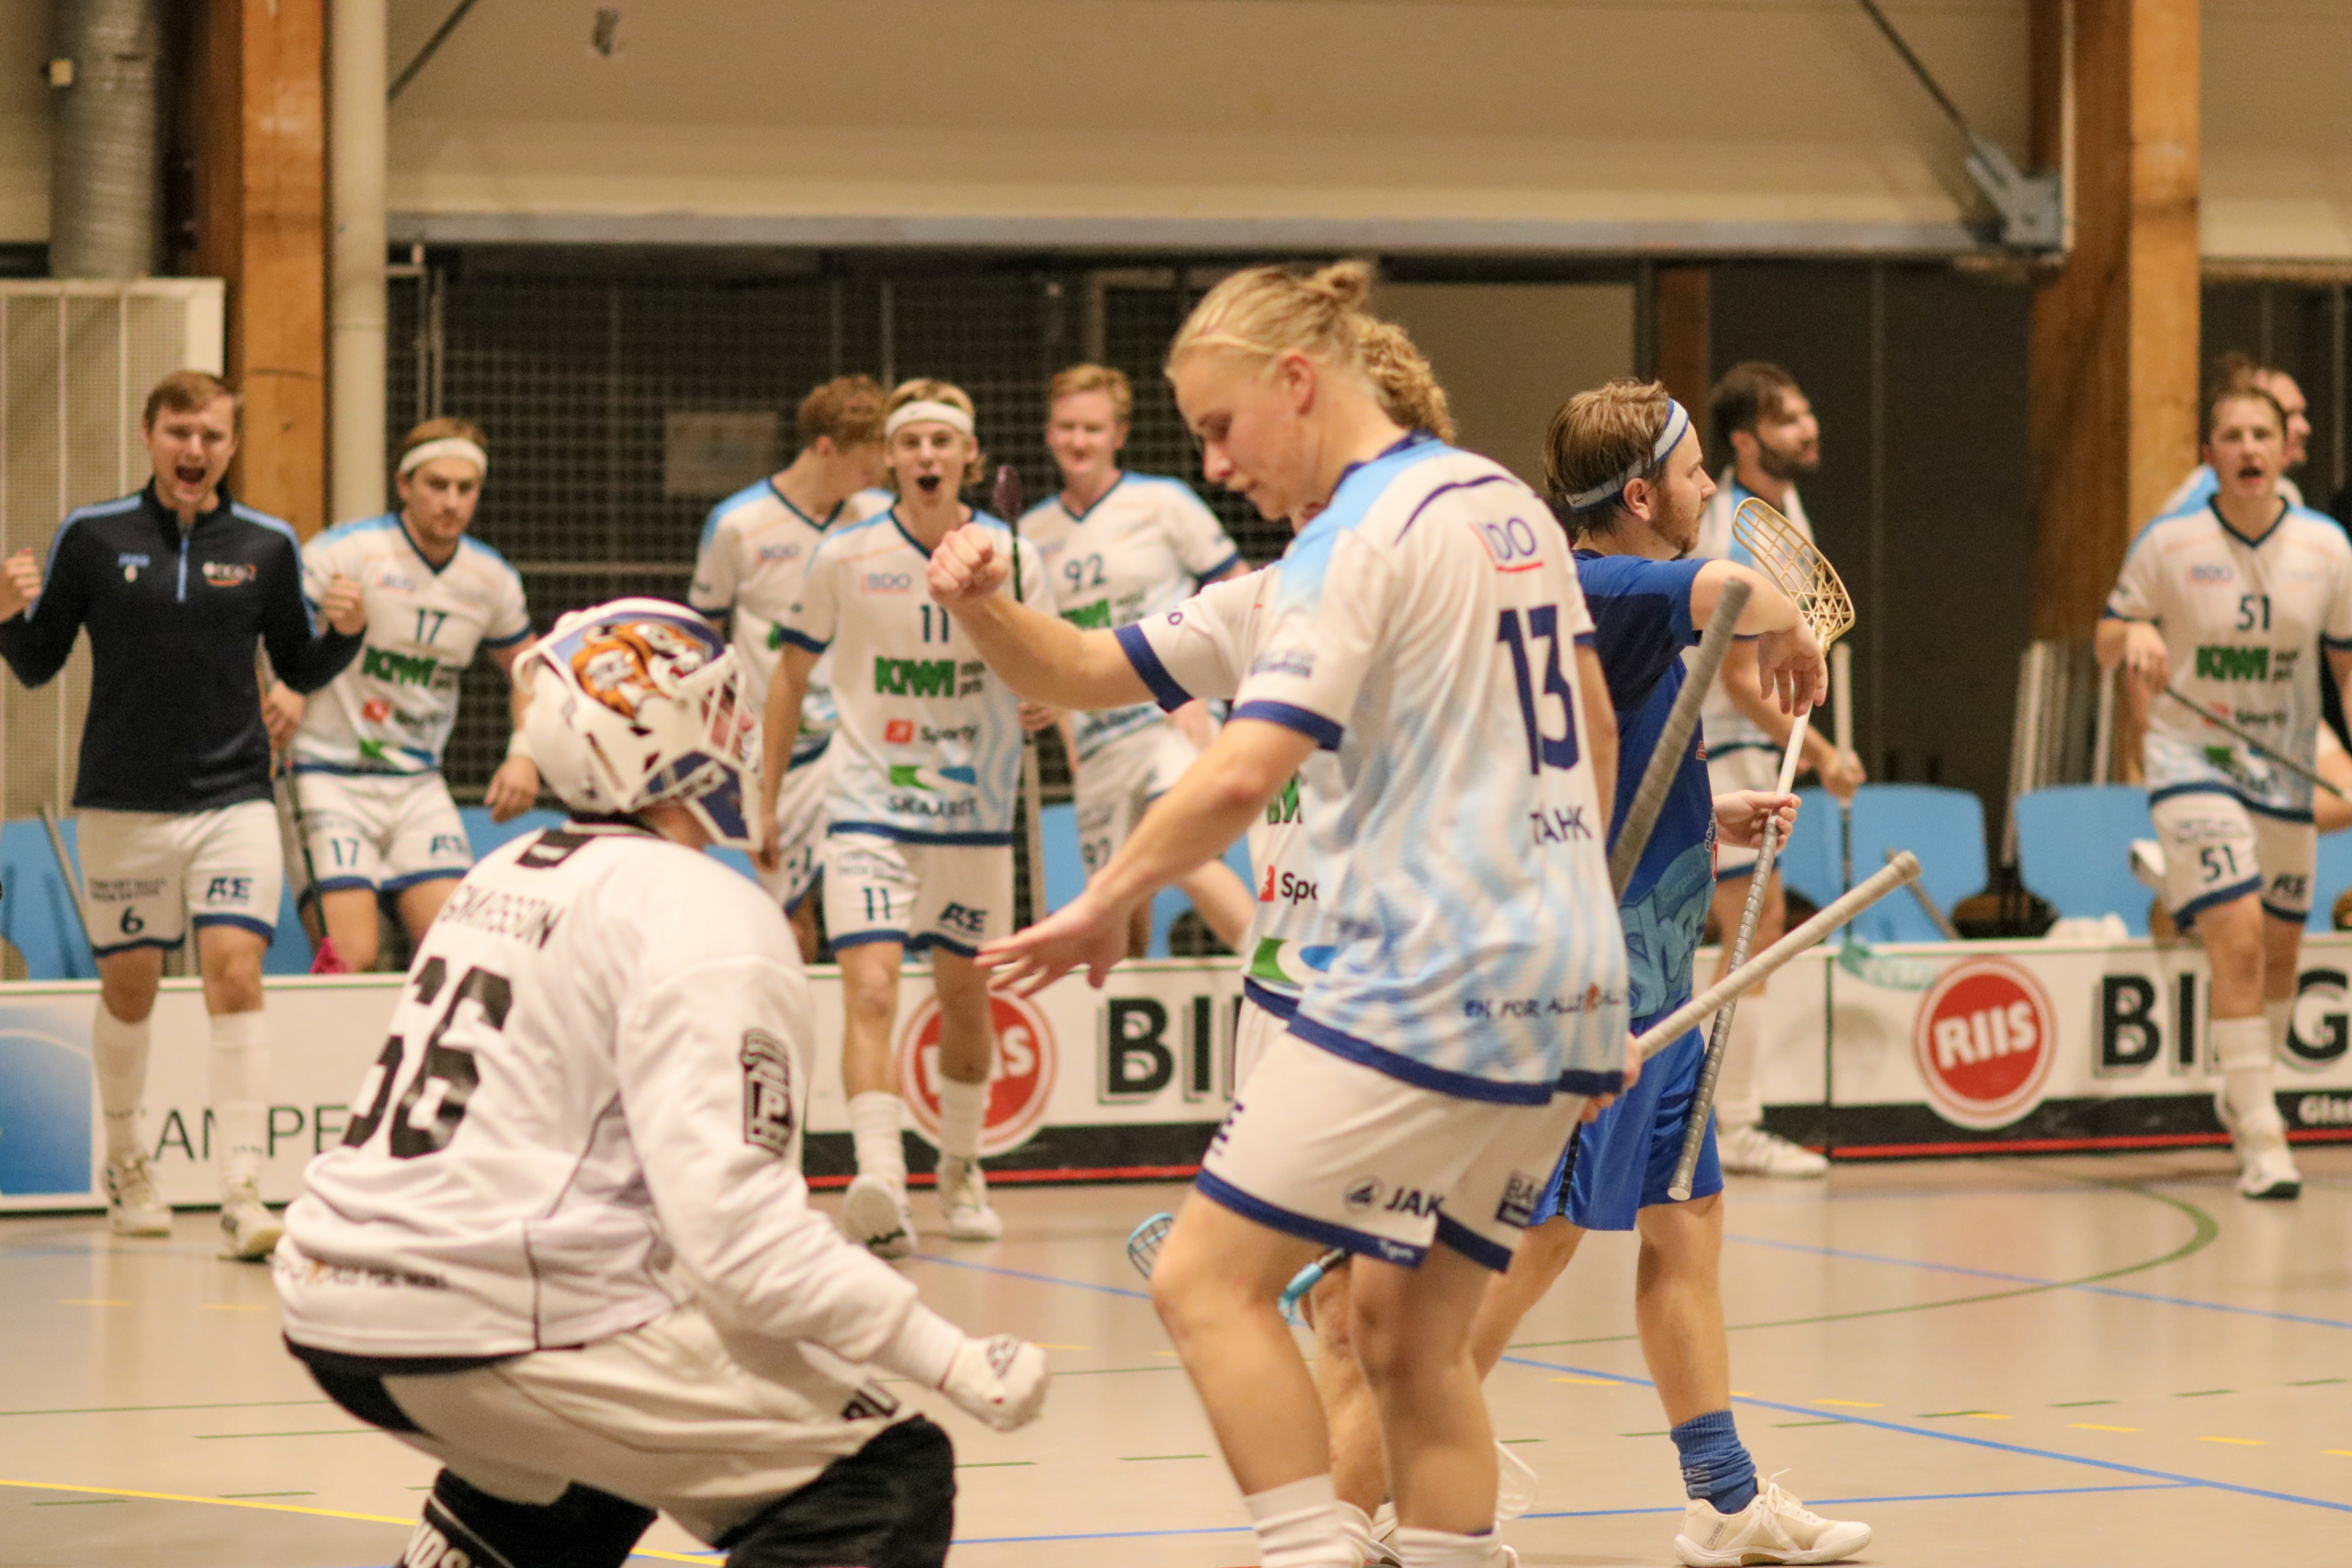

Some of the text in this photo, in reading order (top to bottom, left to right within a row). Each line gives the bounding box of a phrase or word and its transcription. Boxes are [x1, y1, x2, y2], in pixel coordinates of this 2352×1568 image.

[1065, 553, 1107, 592] 92
[417, 607, 448, 644] 17
[920, 604, 950, 643] 11
[2237, 595, 2270, 630] 51
[1497, 604, 1579, 775] 13
[330, 837, 359, 867] 17
[2201, 844, 2237, 883] 51
[119, 907, 144, 935] 6
[863, 886, 891, 920] 11
[1934, 998, 2038, 1070] RIIS
[2096, 967, 2348, 1078] BIG
[1099, 995, 1243, 1105] BI
